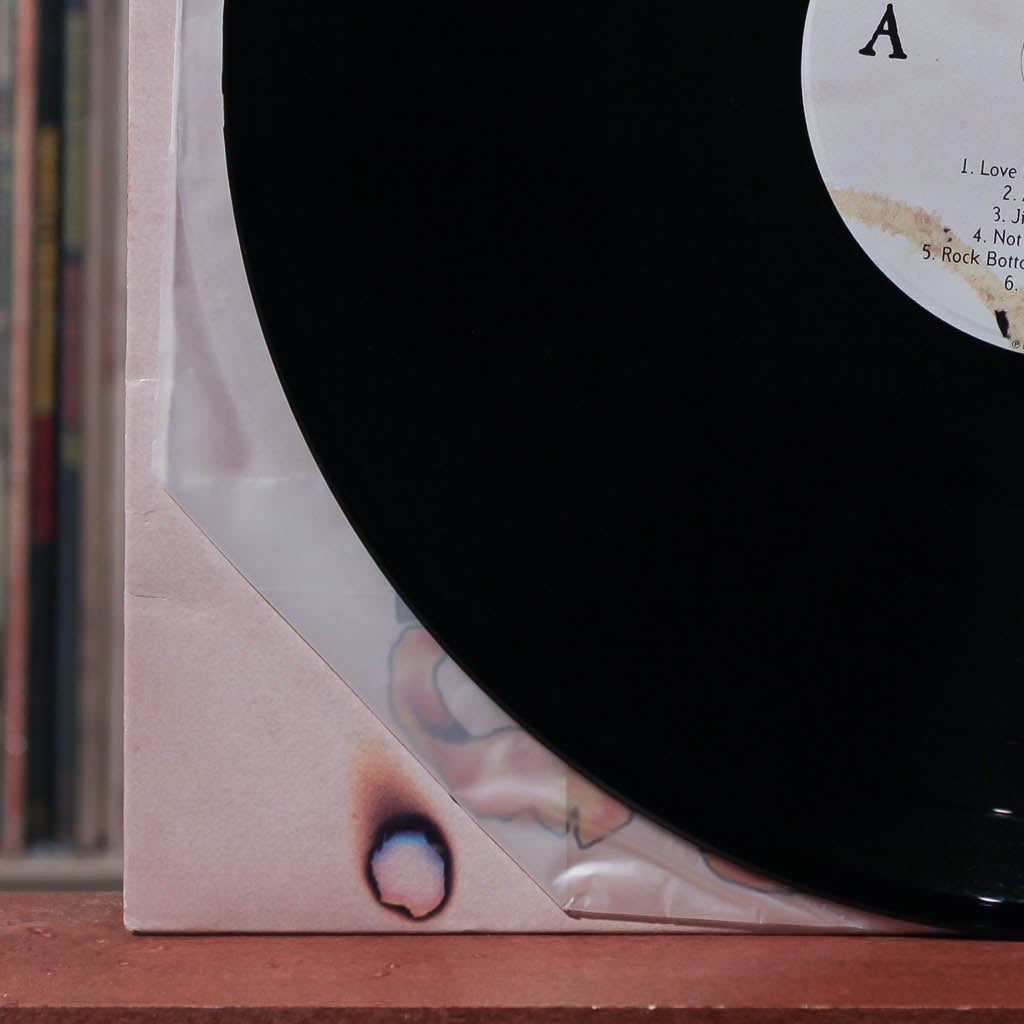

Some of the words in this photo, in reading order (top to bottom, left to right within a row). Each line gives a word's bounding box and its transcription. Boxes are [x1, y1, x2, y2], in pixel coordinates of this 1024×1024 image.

[858, 3, 907, 59] A
[961, 158, 975, 175] 1.
[980, 160, 1017, 179] Love
[1003, 185, 1016, 201] 2.
[992, 207, 1005, 223] 3.
[973, 228, 986, 244] 4.
[994, 229, 1021, 247] Not
[923, 244, 935, 261] 5.
[942, 246, 980, 265] Rock
[1004, 275, 1018, 292] 6.
